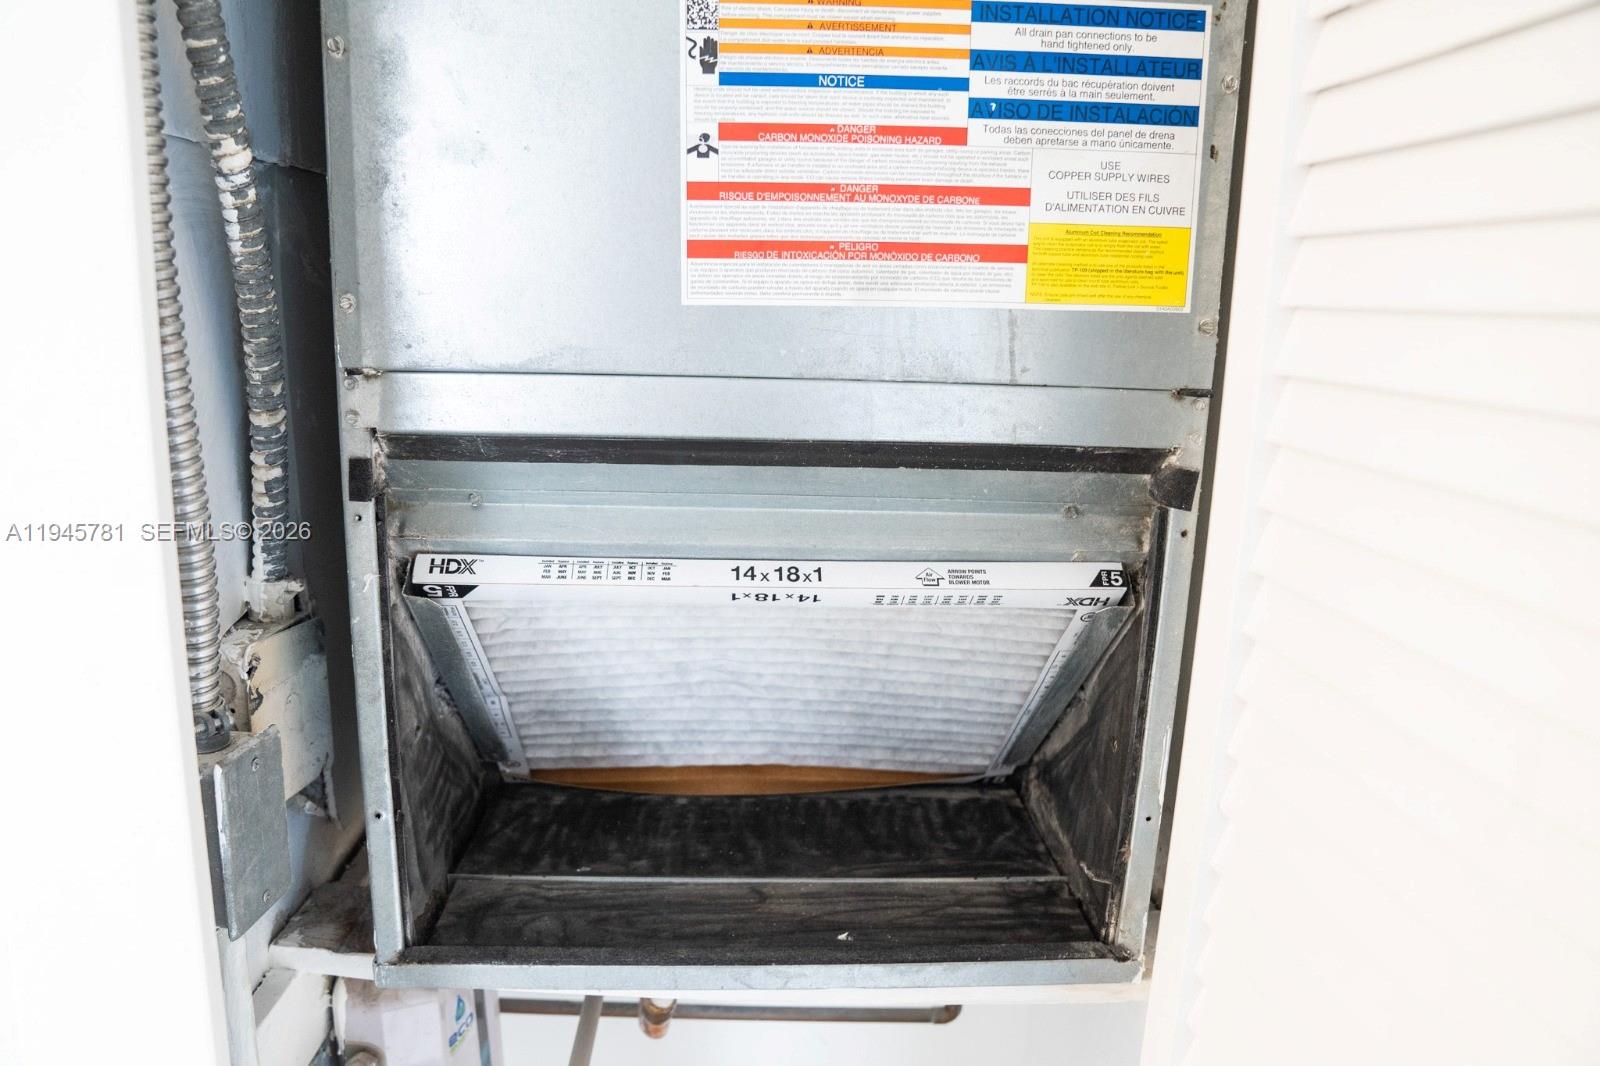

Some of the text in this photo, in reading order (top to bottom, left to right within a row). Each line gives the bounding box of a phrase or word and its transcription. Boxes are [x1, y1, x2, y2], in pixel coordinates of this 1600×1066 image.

[980, 4, 1198, 30] INSTALLATION NOTICE
[819, 22, 896, 32] AVERTISSEMENT
[1014, 27, 1158, 42] All drain pan connections to be
[818, 47, 885, 56] ADVERTENCIA
[1041, 39, 1135, 53] hand tightened only.
[972, 53, 1017, 71] AVIS
[1023, 51, 1036, 72] À
[1042, 55, 1200, 79] L'INSTALLATEUR
[818, 75, 865, 87] NOTICE
[984, 75, 1175, 92] Les raccords du bac récupération doivent
[1007, 86, 1025, 96] être
[1028, 87, 1057, 97] serrés
[1069, 89, 1077, 98] la
[1080, 90, 1102, 99] main
[1105, 91, 1155, 101] seulement.
[972, 101, 1031, 119] AVISO
[1038, 103, 1062, 120] DE
[1069, 103, 1196, 127] INSTALACIÓN
[837, 125, 877, 134] DANGER
[984, 124, 1175, 140] Todas las conecciones del panel de drena
[758, 133, 942, 145] CARBON MONOXIDE POISONING HAZARD
[1003, 135, 1033, 145] deben
[1035, 137, 1079, 148] apretarse
[1090, 140, 1116, 148] mano
[1119, 139, 1174, 150] únicamente.
[1100, 161, 1121, 170] USE
[1048, 170, 1170, 184] COPPER SUPPLY WIRES
[840, 184, 879, 193] DANGER
[719, 191, 981, 205] RISQUE D'EMPOISONNEMENT AU MONOXYDE DE CARBONE
[1066, 191, 1160, 203] UTILISER DES FILS
[1045, 202, 1186, 216] D'ALIMENTATION EN CUIVRE
[839, 242, 879, 251] PELIGRO
[734, 250, 981, 263] RIESGO DE INTOXICACIÓN POR MONÓXIDO DE CARBONO
[428, 558, 478, 575] HDX
[1101, 570, 1123, 587] FPR 5
[422, 585, 459, 598] 5 FPR
[1064, 597, 1111, 607] HDX
